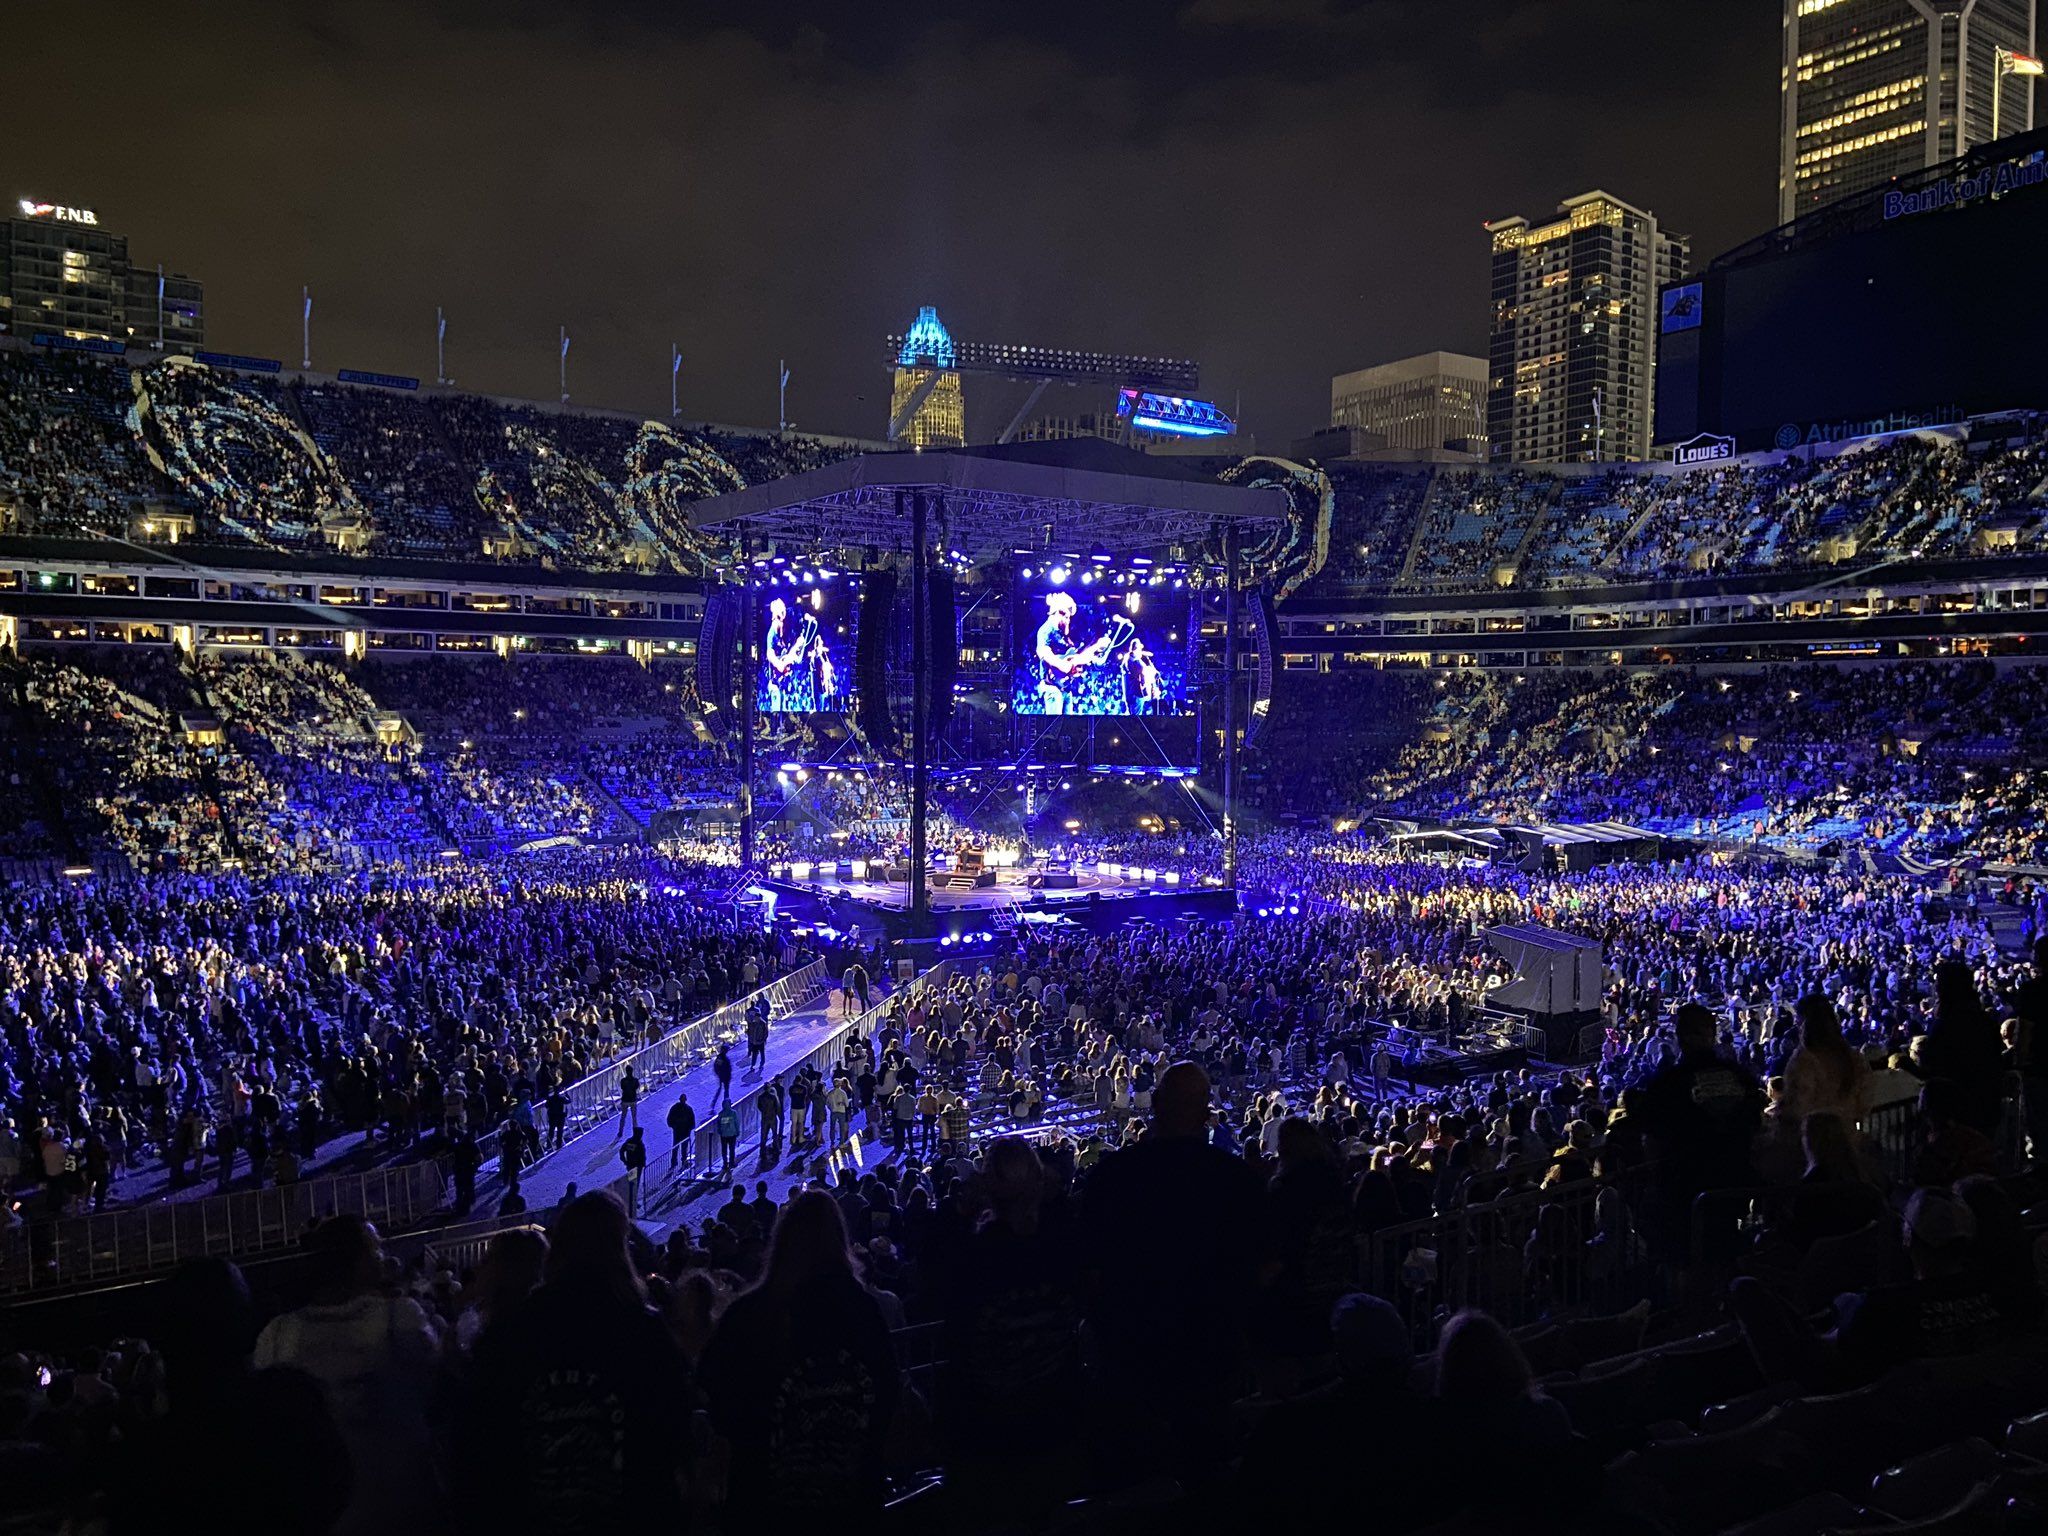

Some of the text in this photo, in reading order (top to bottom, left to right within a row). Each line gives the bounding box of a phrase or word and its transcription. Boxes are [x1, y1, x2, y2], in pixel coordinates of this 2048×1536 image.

[1883, 178, 1957, 221] Bank
[1959, 166, 1992, 201] of
[1806, 402, 1966, 445] Atrium Health
[1679, 442, 1730, 464] LOWE'S
